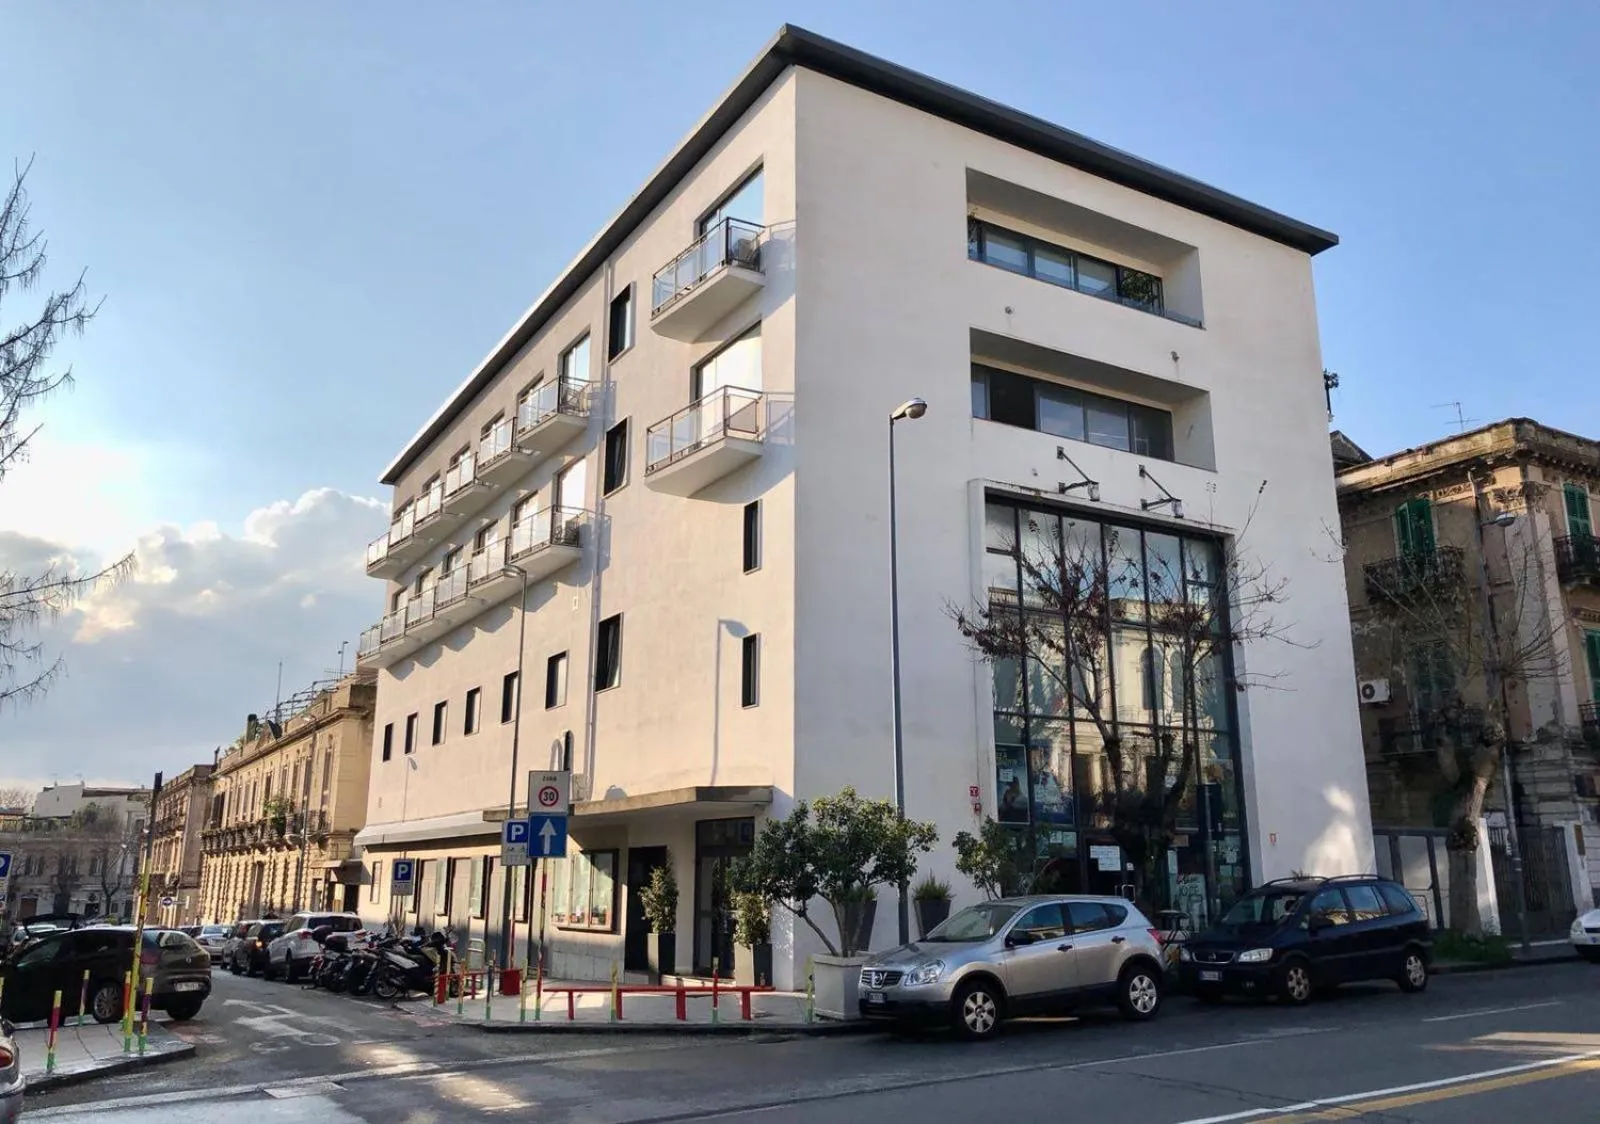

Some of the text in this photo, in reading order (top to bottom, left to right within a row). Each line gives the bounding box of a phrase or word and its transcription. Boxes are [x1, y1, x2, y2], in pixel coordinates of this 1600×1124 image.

[543, 791, 555, 802] 30
[511, 824, 525, 841] P
[398, 864, 409, 879] P
